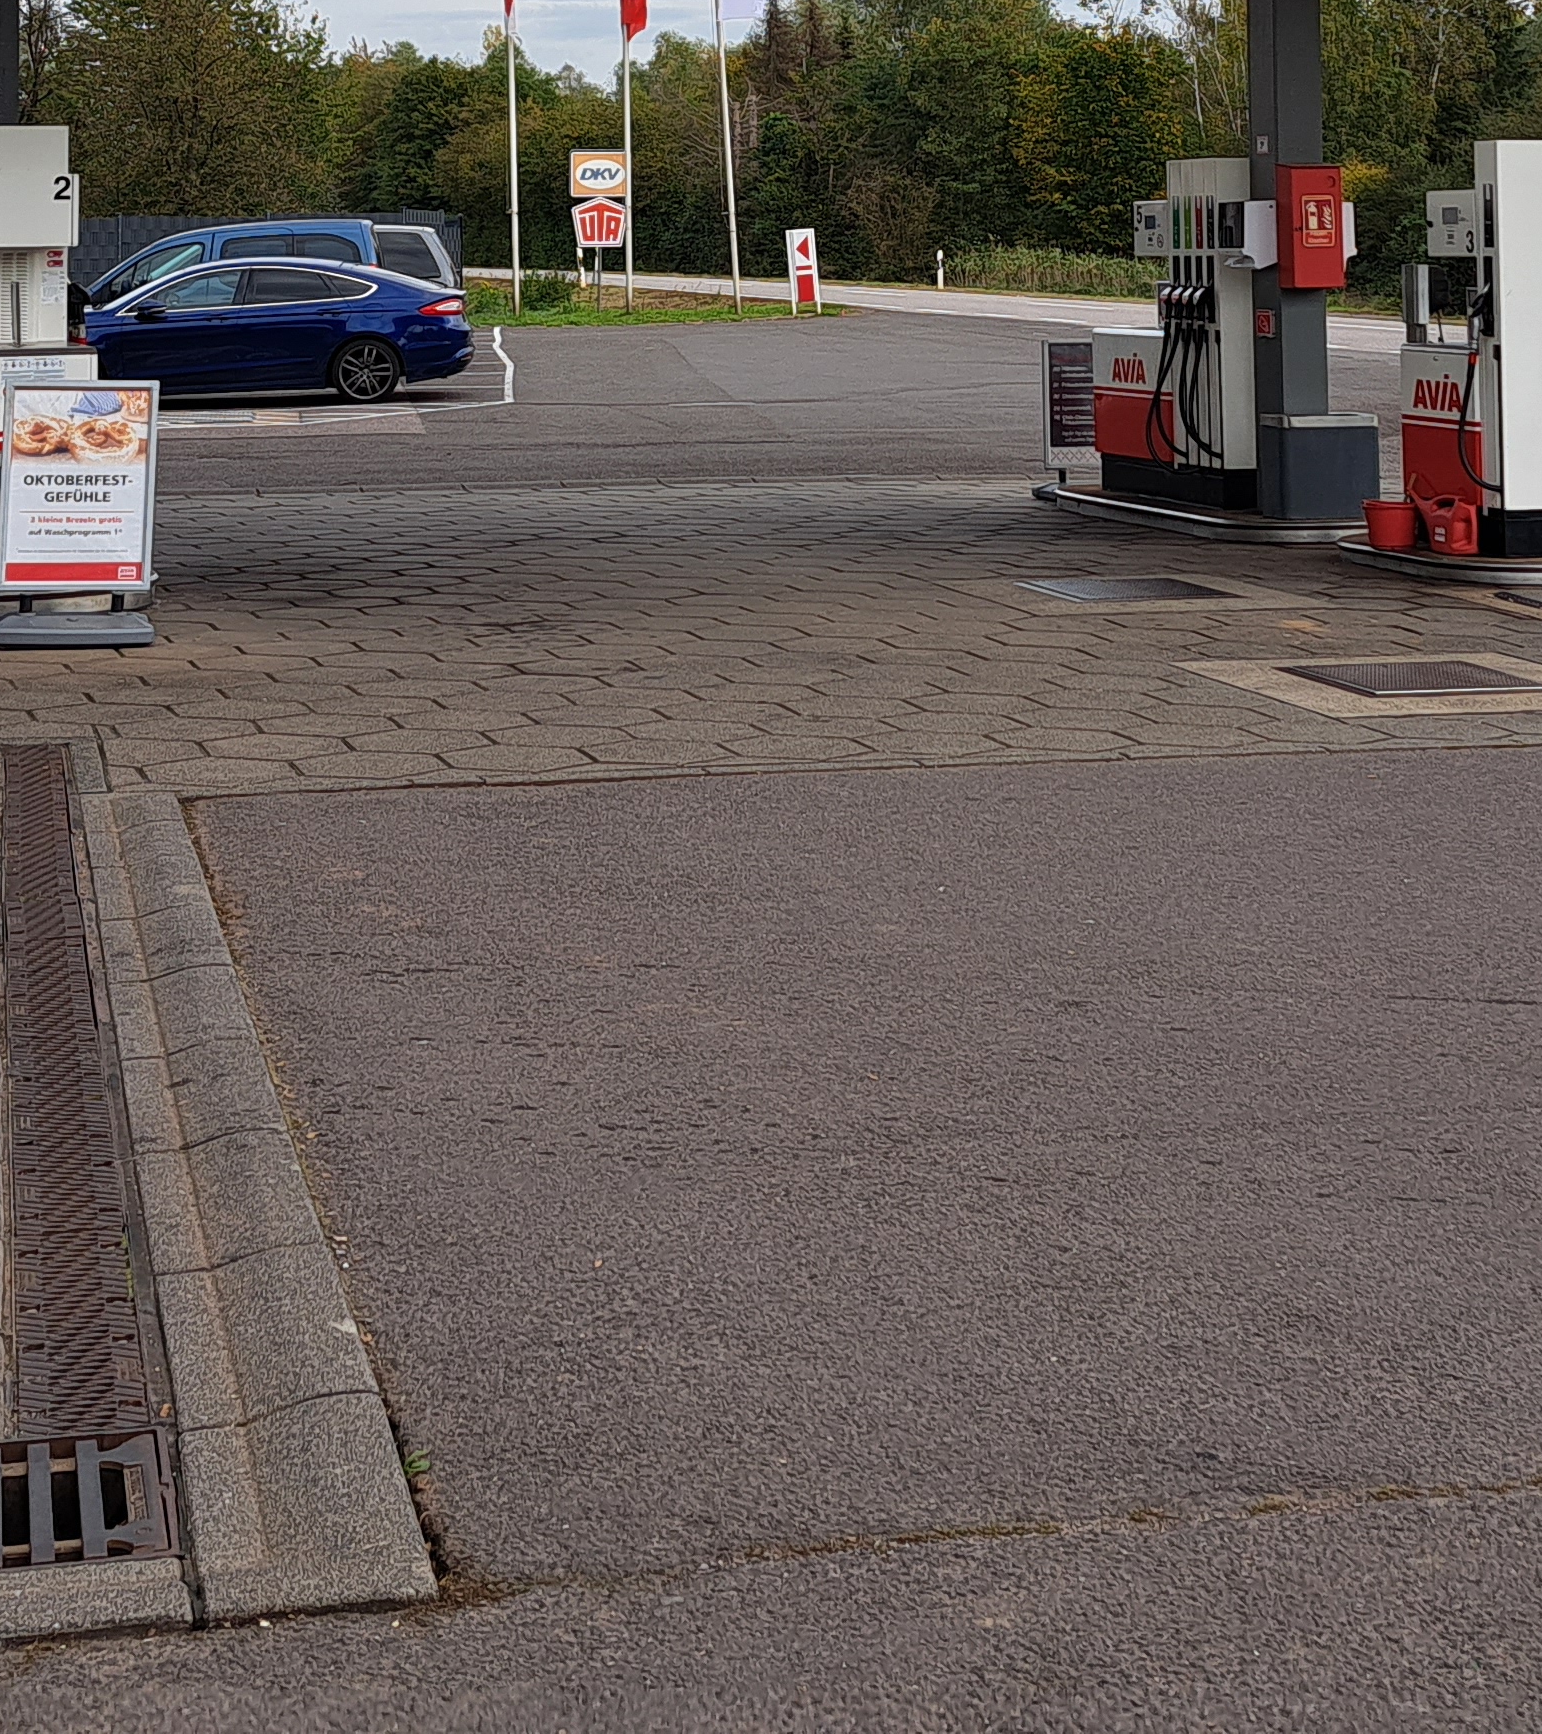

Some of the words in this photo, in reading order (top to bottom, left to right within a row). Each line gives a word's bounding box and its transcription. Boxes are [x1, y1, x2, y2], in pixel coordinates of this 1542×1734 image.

[579, 167, 621, 181] DKV
[53, 175, 71, 200] 2
[578, 202, 623, 242] UTA
[1136, 205, 1143, 224] 5
[1465, 230, 1475, 253] 3
[23, 474, 133, 486] OKTOBERFEST-
[44, 489, 111, 503] GEFÜHLE
[98, 516, 122, 525] gratis
